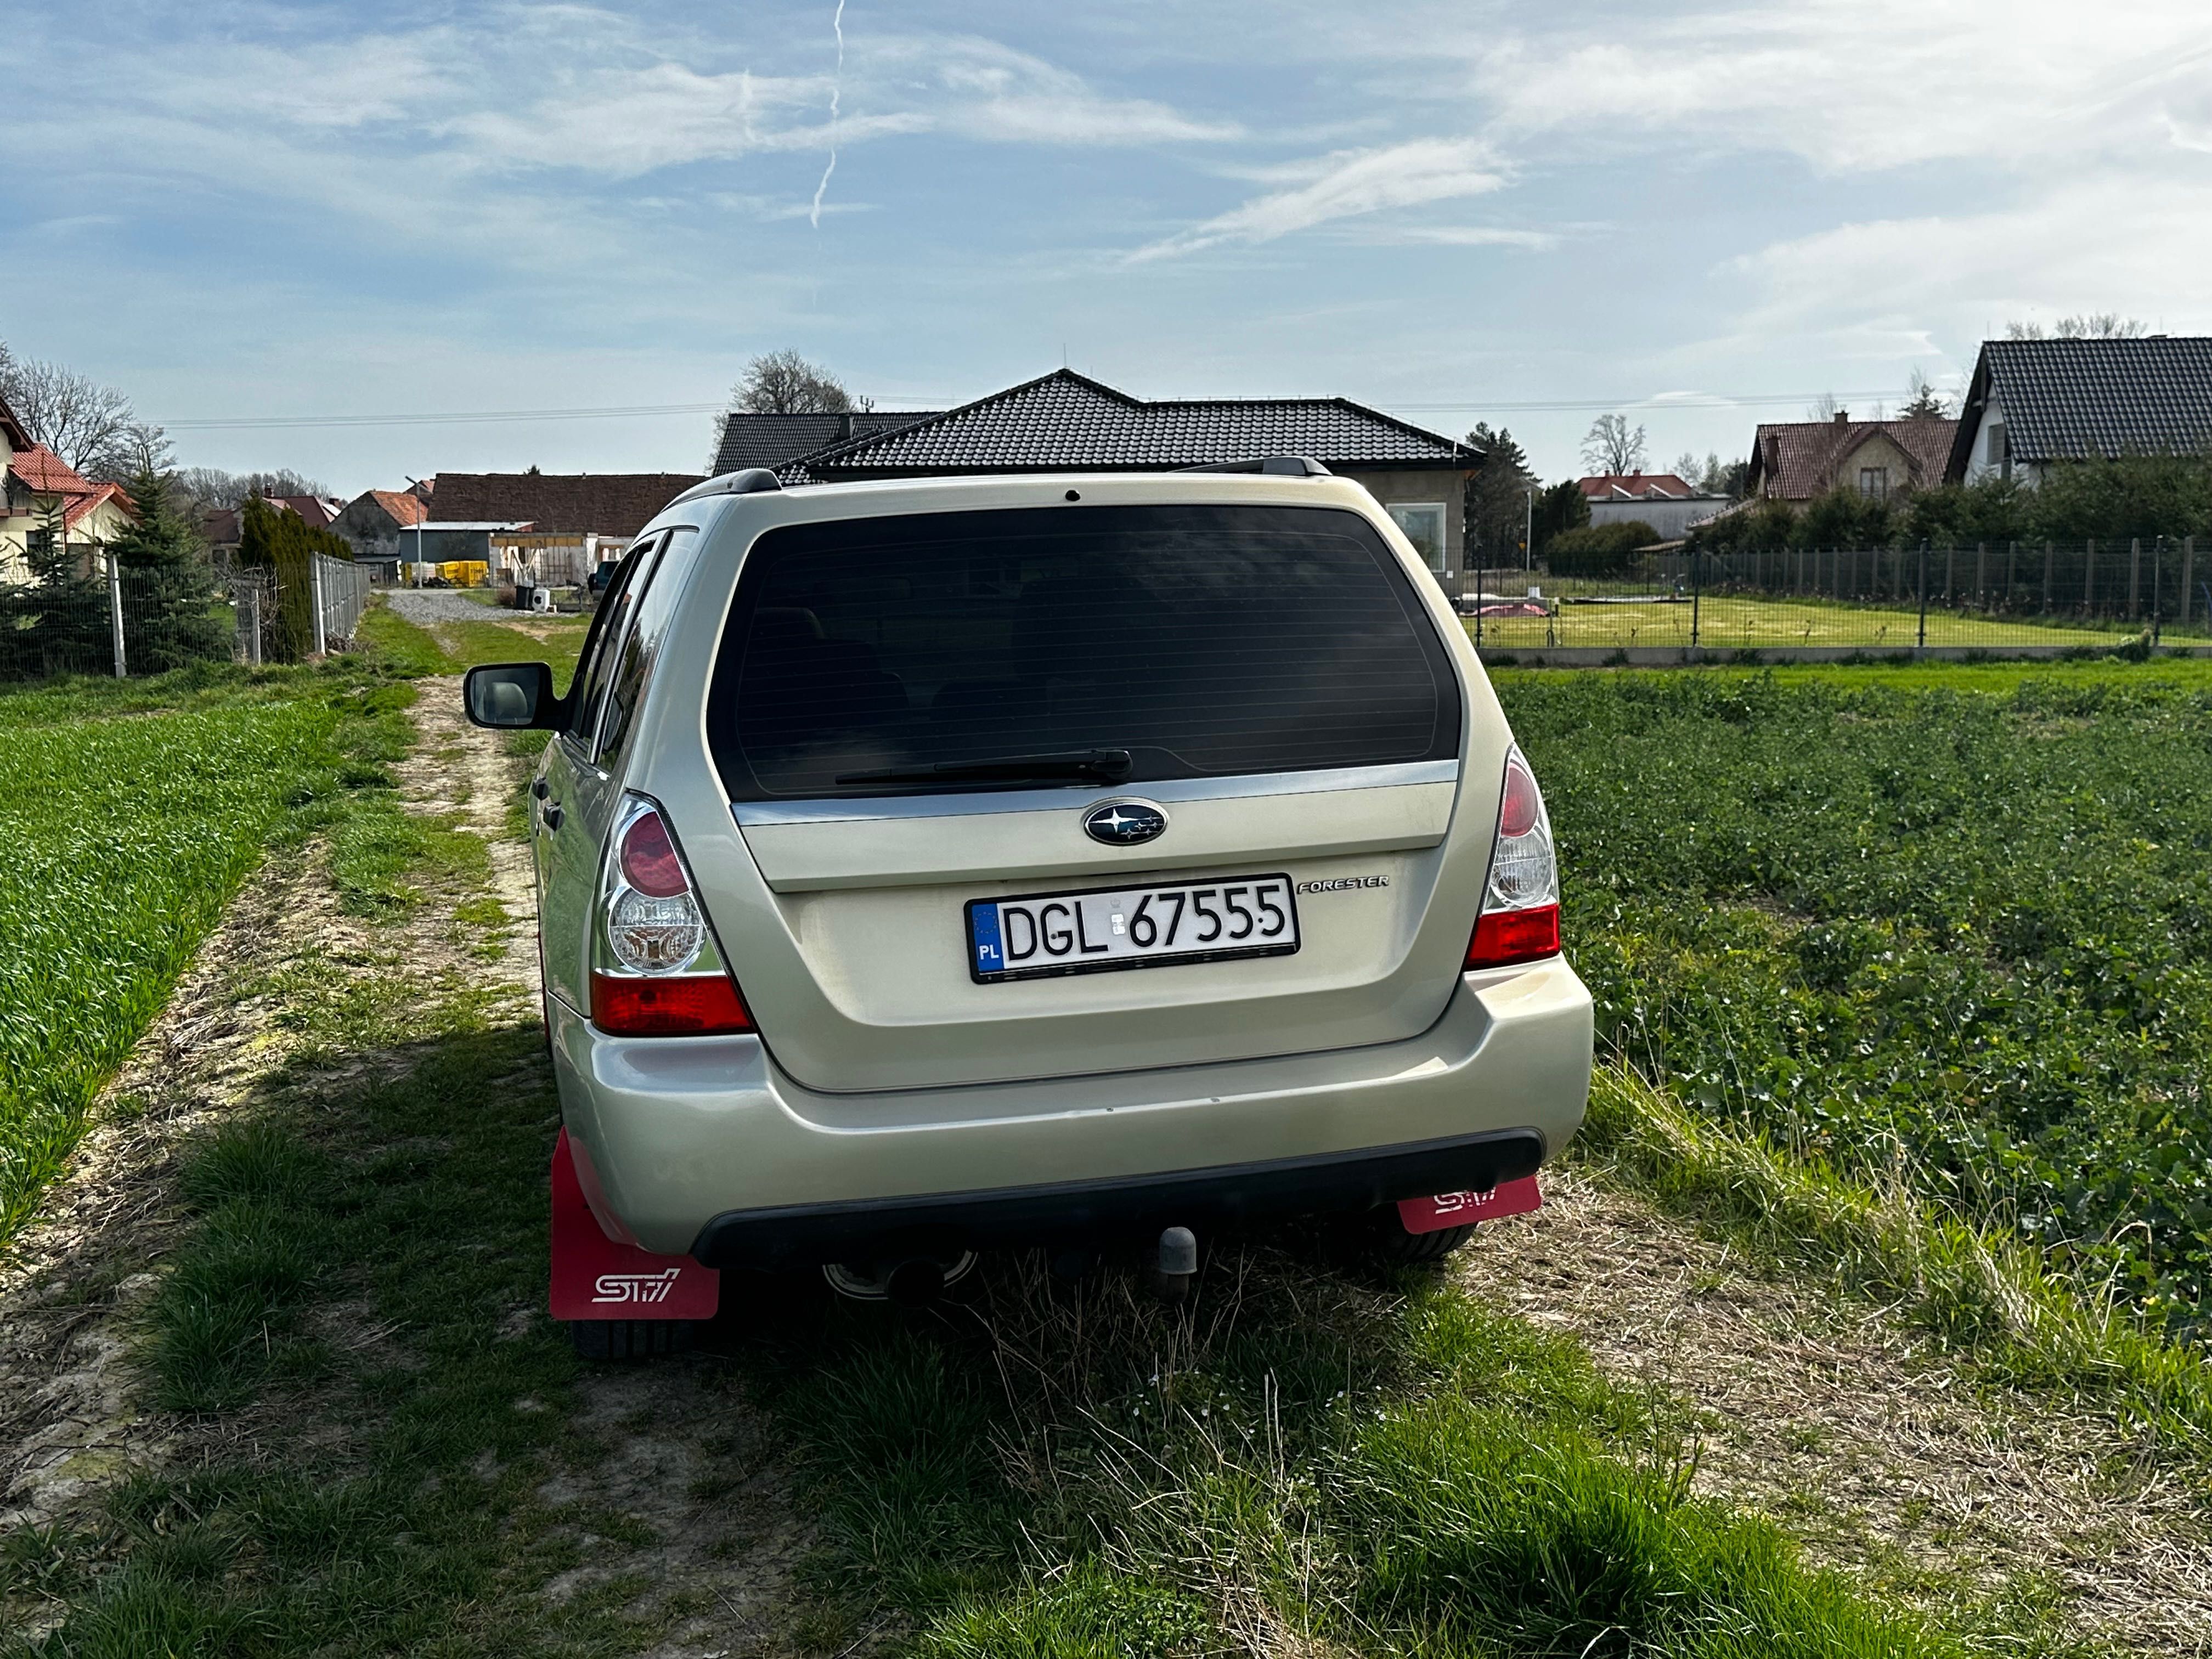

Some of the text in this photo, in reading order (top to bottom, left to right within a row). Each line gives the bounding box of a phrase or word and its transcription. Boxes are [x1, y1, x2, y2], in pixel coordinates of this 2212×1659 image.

[1297, 876, 1389, 894] FORESTER
[1003, 885, 1285, 961] DGL 67555
[979, 944, 999, 960] PL
